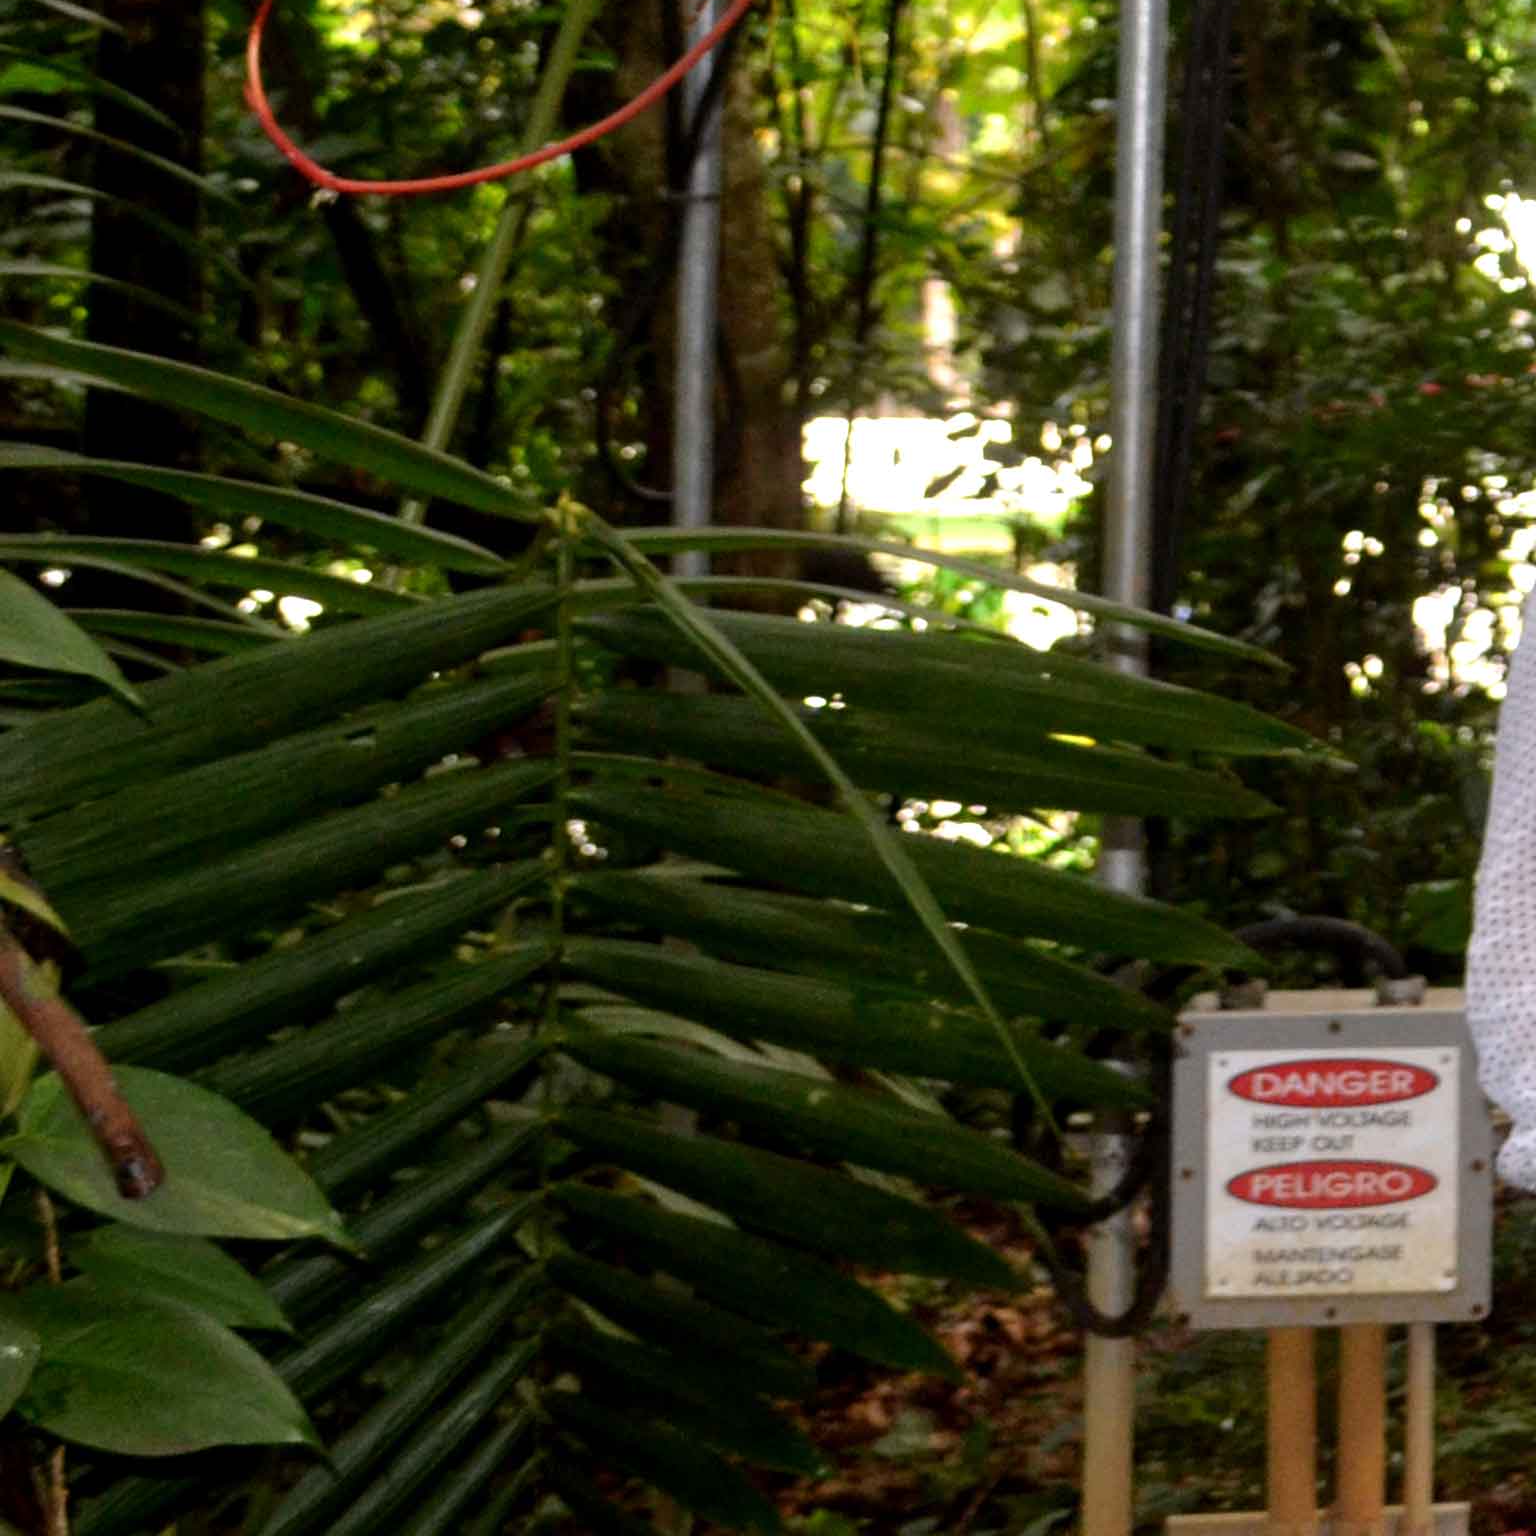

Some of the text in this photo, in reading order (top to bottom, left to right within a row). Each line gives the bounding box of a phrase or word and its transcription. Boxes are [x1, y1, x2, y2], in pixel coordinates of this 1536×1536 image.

[1252, 1069, 1415, 1099] DANGER
[1252, 1110, 1412, 1129] HIGH VOLTAGE
[1252, 1134, 1354, 1152] KEEP OUT
[1250, 1169, 1413, 1200] PELIGRO
[1253, 1212, 1408, 1231] ALTO VOLTAGE
[1254, 1245, 1403, 1263] MANTENGASE
[1254, 1268, 1354, 1286] ALEJADO
